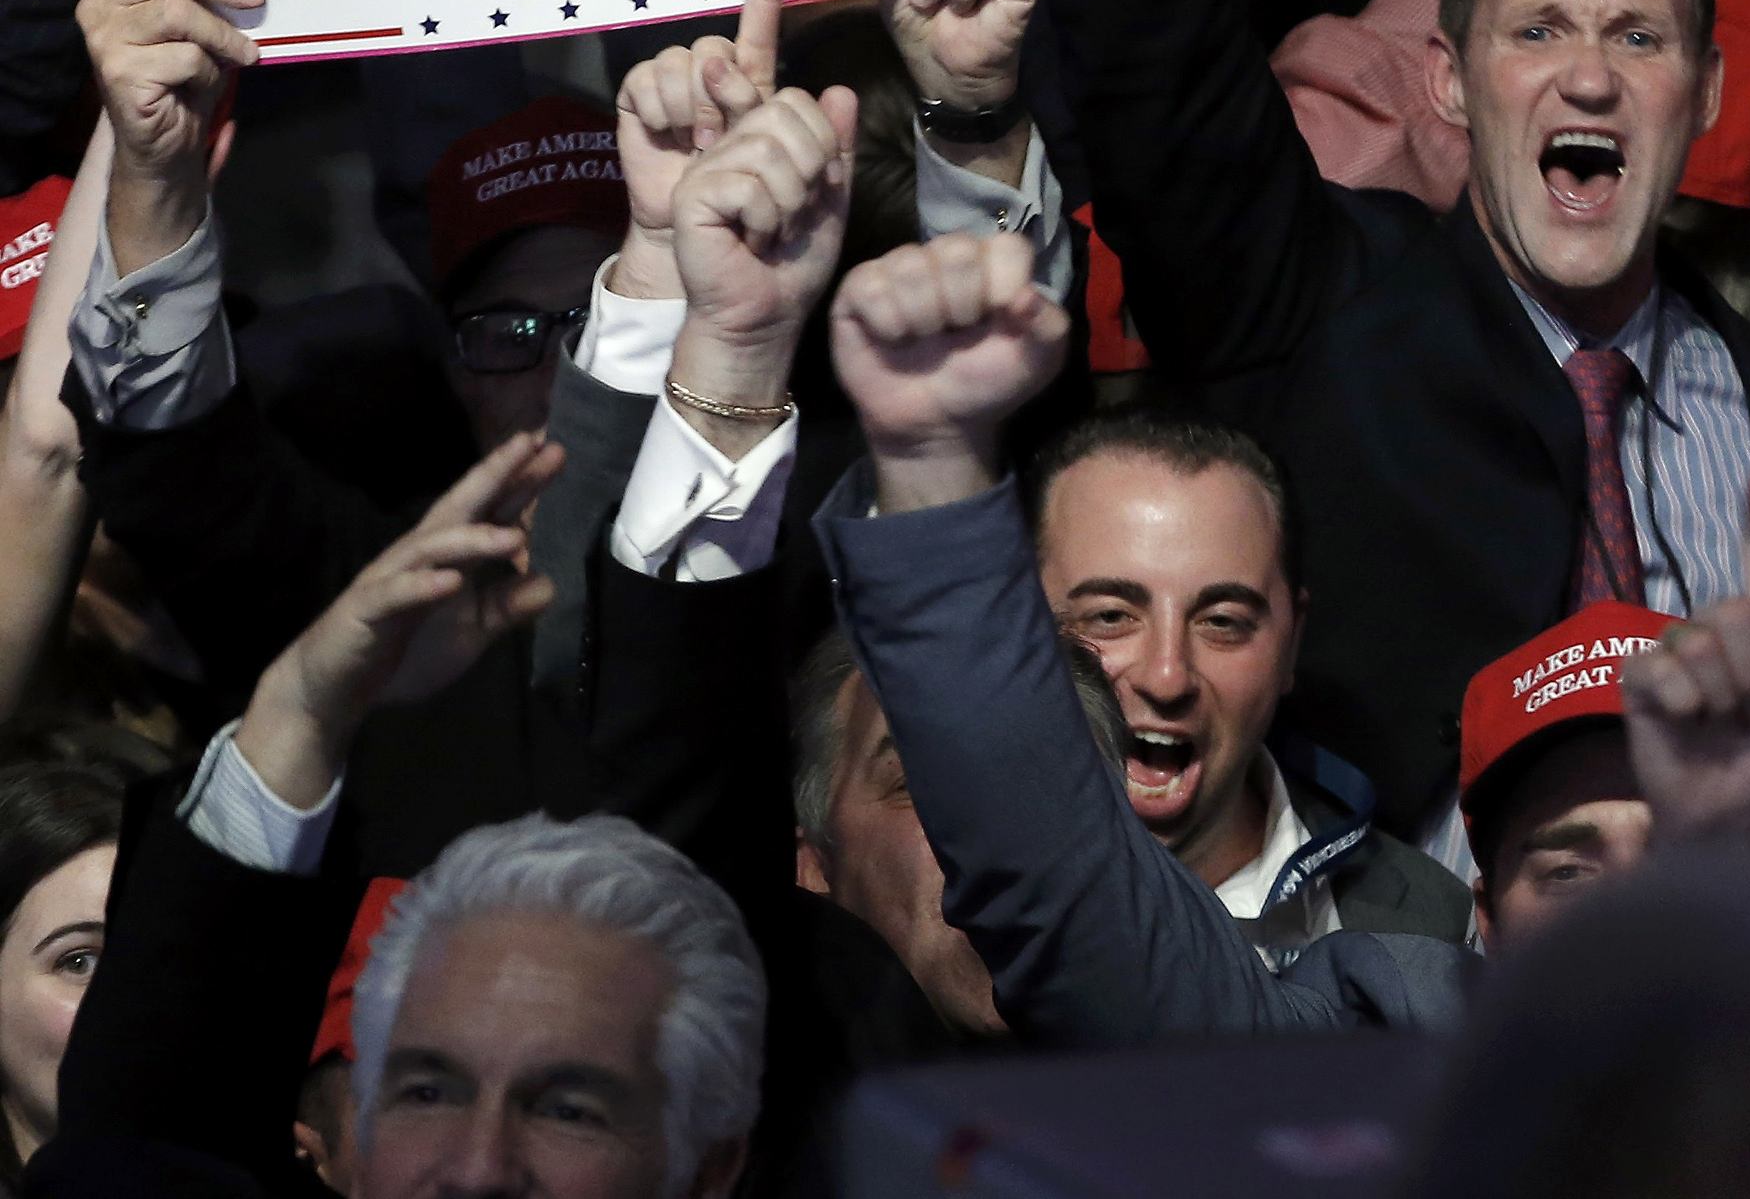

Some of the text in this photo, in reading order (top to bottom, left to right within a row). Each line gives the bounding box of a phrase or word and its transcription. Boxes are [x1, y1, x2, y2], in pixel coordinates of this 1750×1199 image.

[462, 140, 532, 181] MAKE
[476, 163, 558, 203] GREAT
[0, 221, 56, 264] AKE
[1513, 644, 1585, 698] MAKE
[1525, 666, 1614, 713] GREAT
